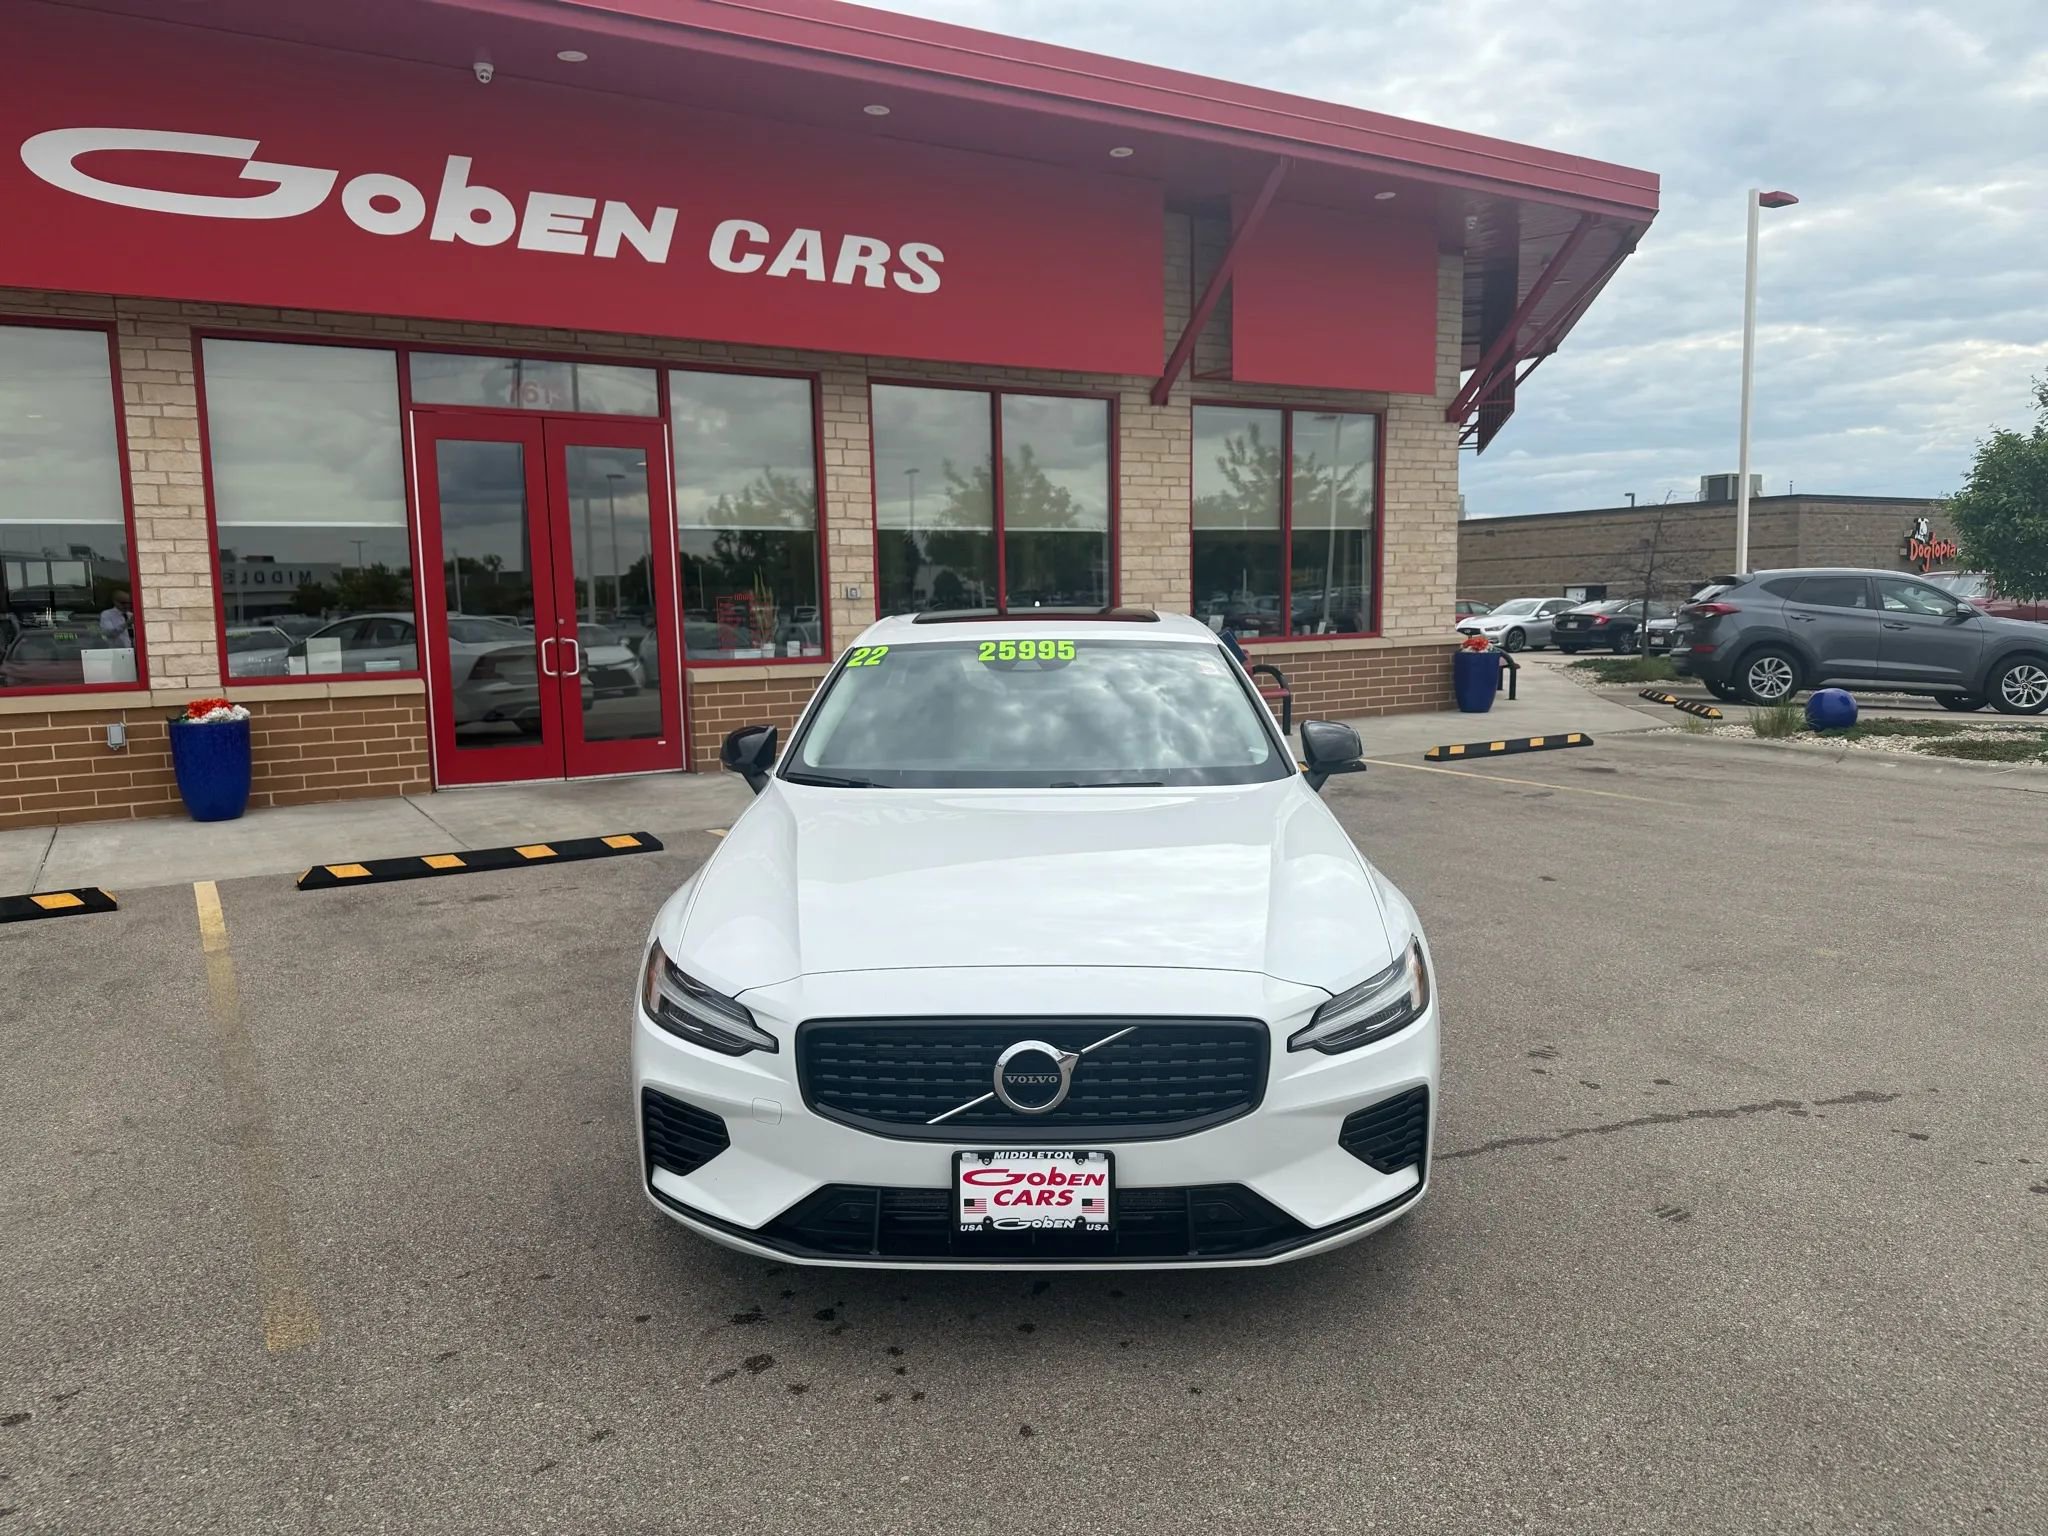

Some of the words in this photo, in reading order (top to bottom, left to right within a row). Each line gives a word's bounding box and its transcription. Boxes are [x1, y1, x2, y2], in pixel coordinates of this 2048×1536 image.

[708, 219, 945, 294] CARS
[1909, 531, 1957, 572] Dogtopia
[846, 646, 889, 668] 22
[978, 640, 1076, 662] 25995
[1005, 1075, 1058, 1084] VOLVO
[993, 1151, 1074, 1160] MIDDLETON
[993, 1189, 1075, 1207] CARS
[960, 1224, 983, 1232] USA
[1086, 1223, 1109, 1231] USA
